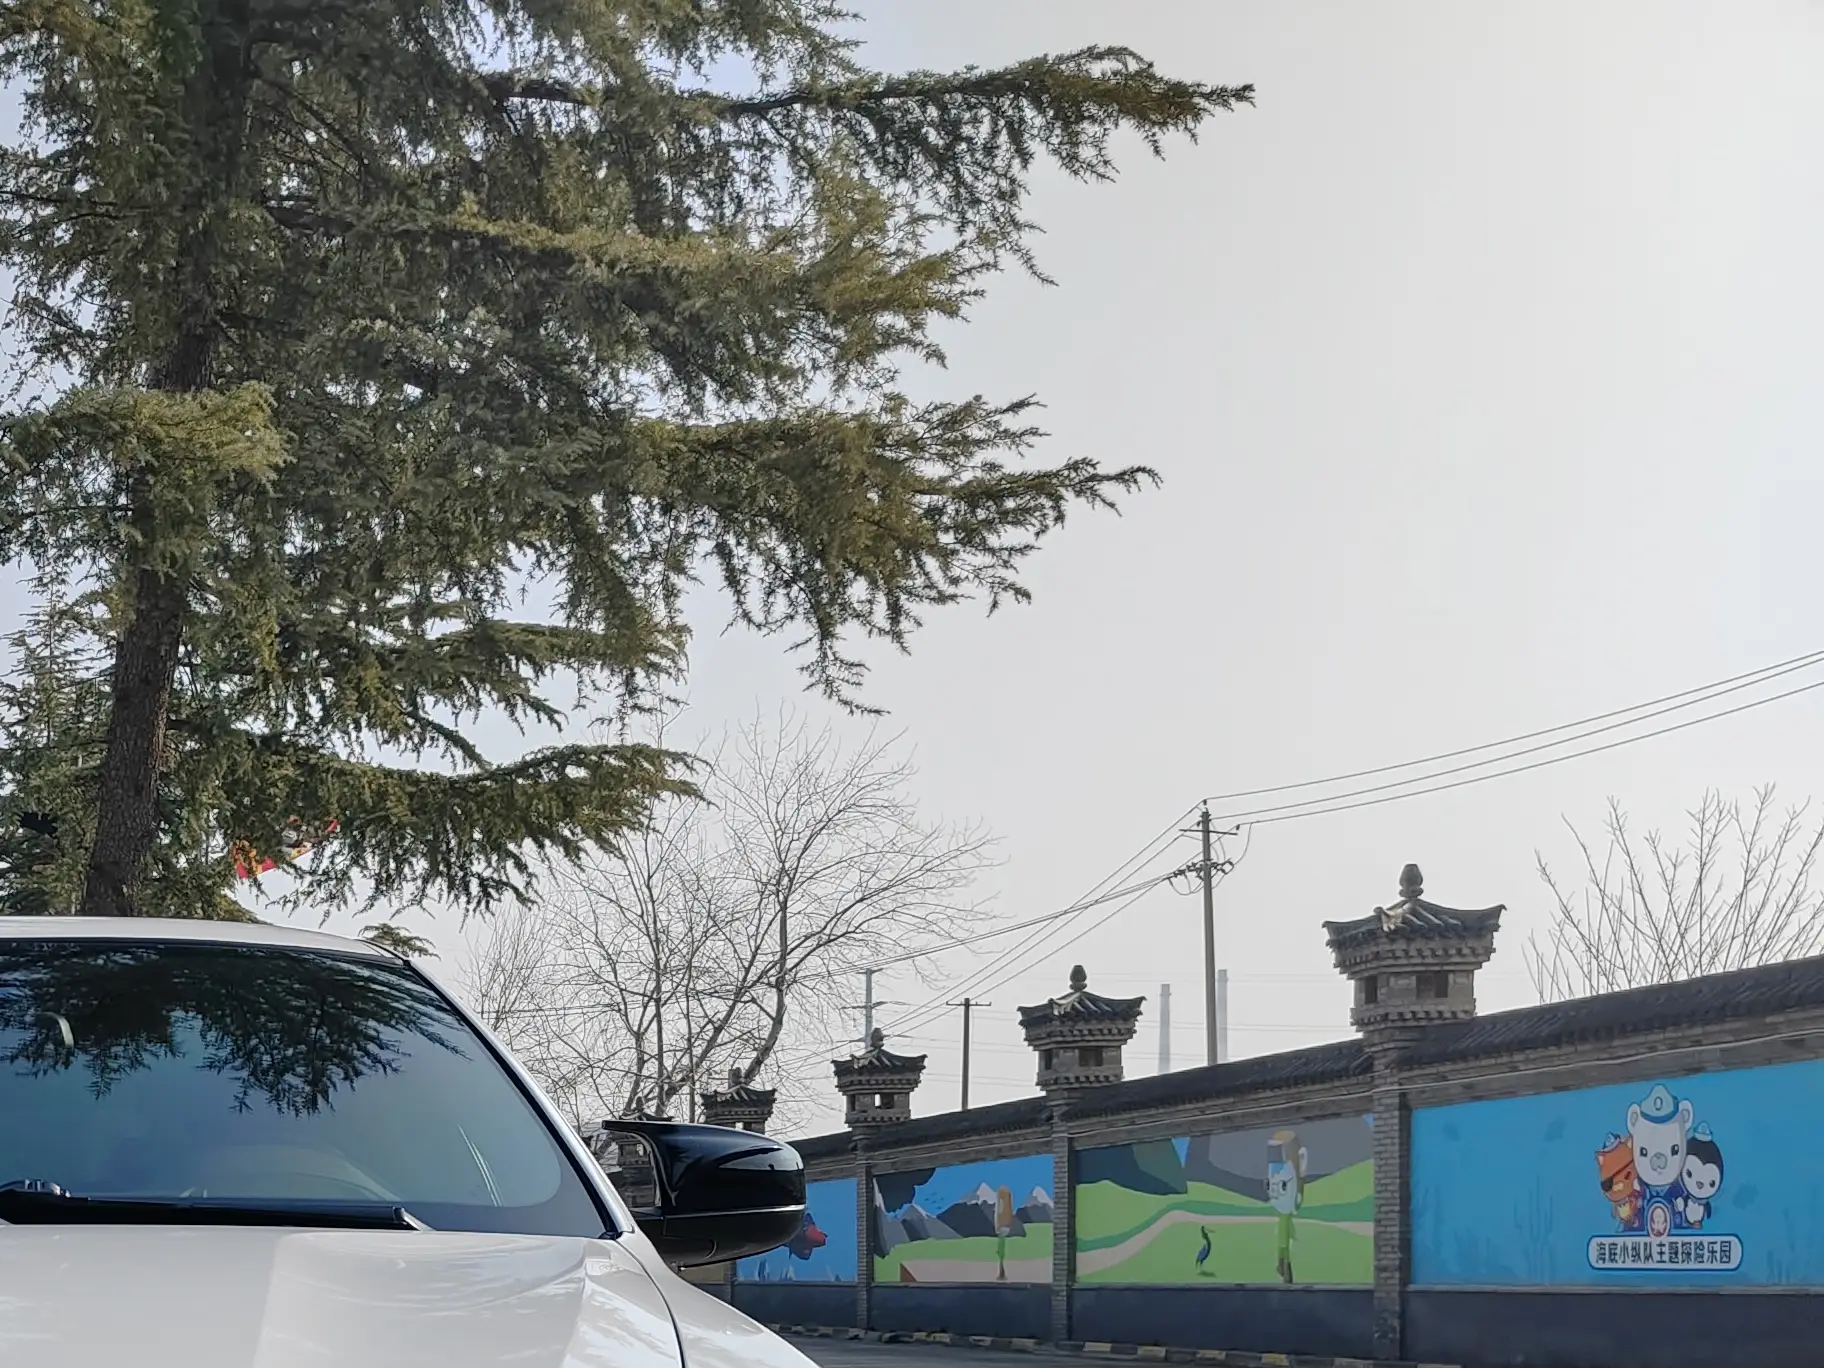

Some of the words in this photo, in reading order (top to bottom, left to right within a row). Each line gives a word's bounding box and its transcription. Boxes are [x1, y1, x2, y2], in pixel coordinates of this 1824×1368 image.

[1595, 1240, 1732, 1265] 海底小纵队主题探险乐园
